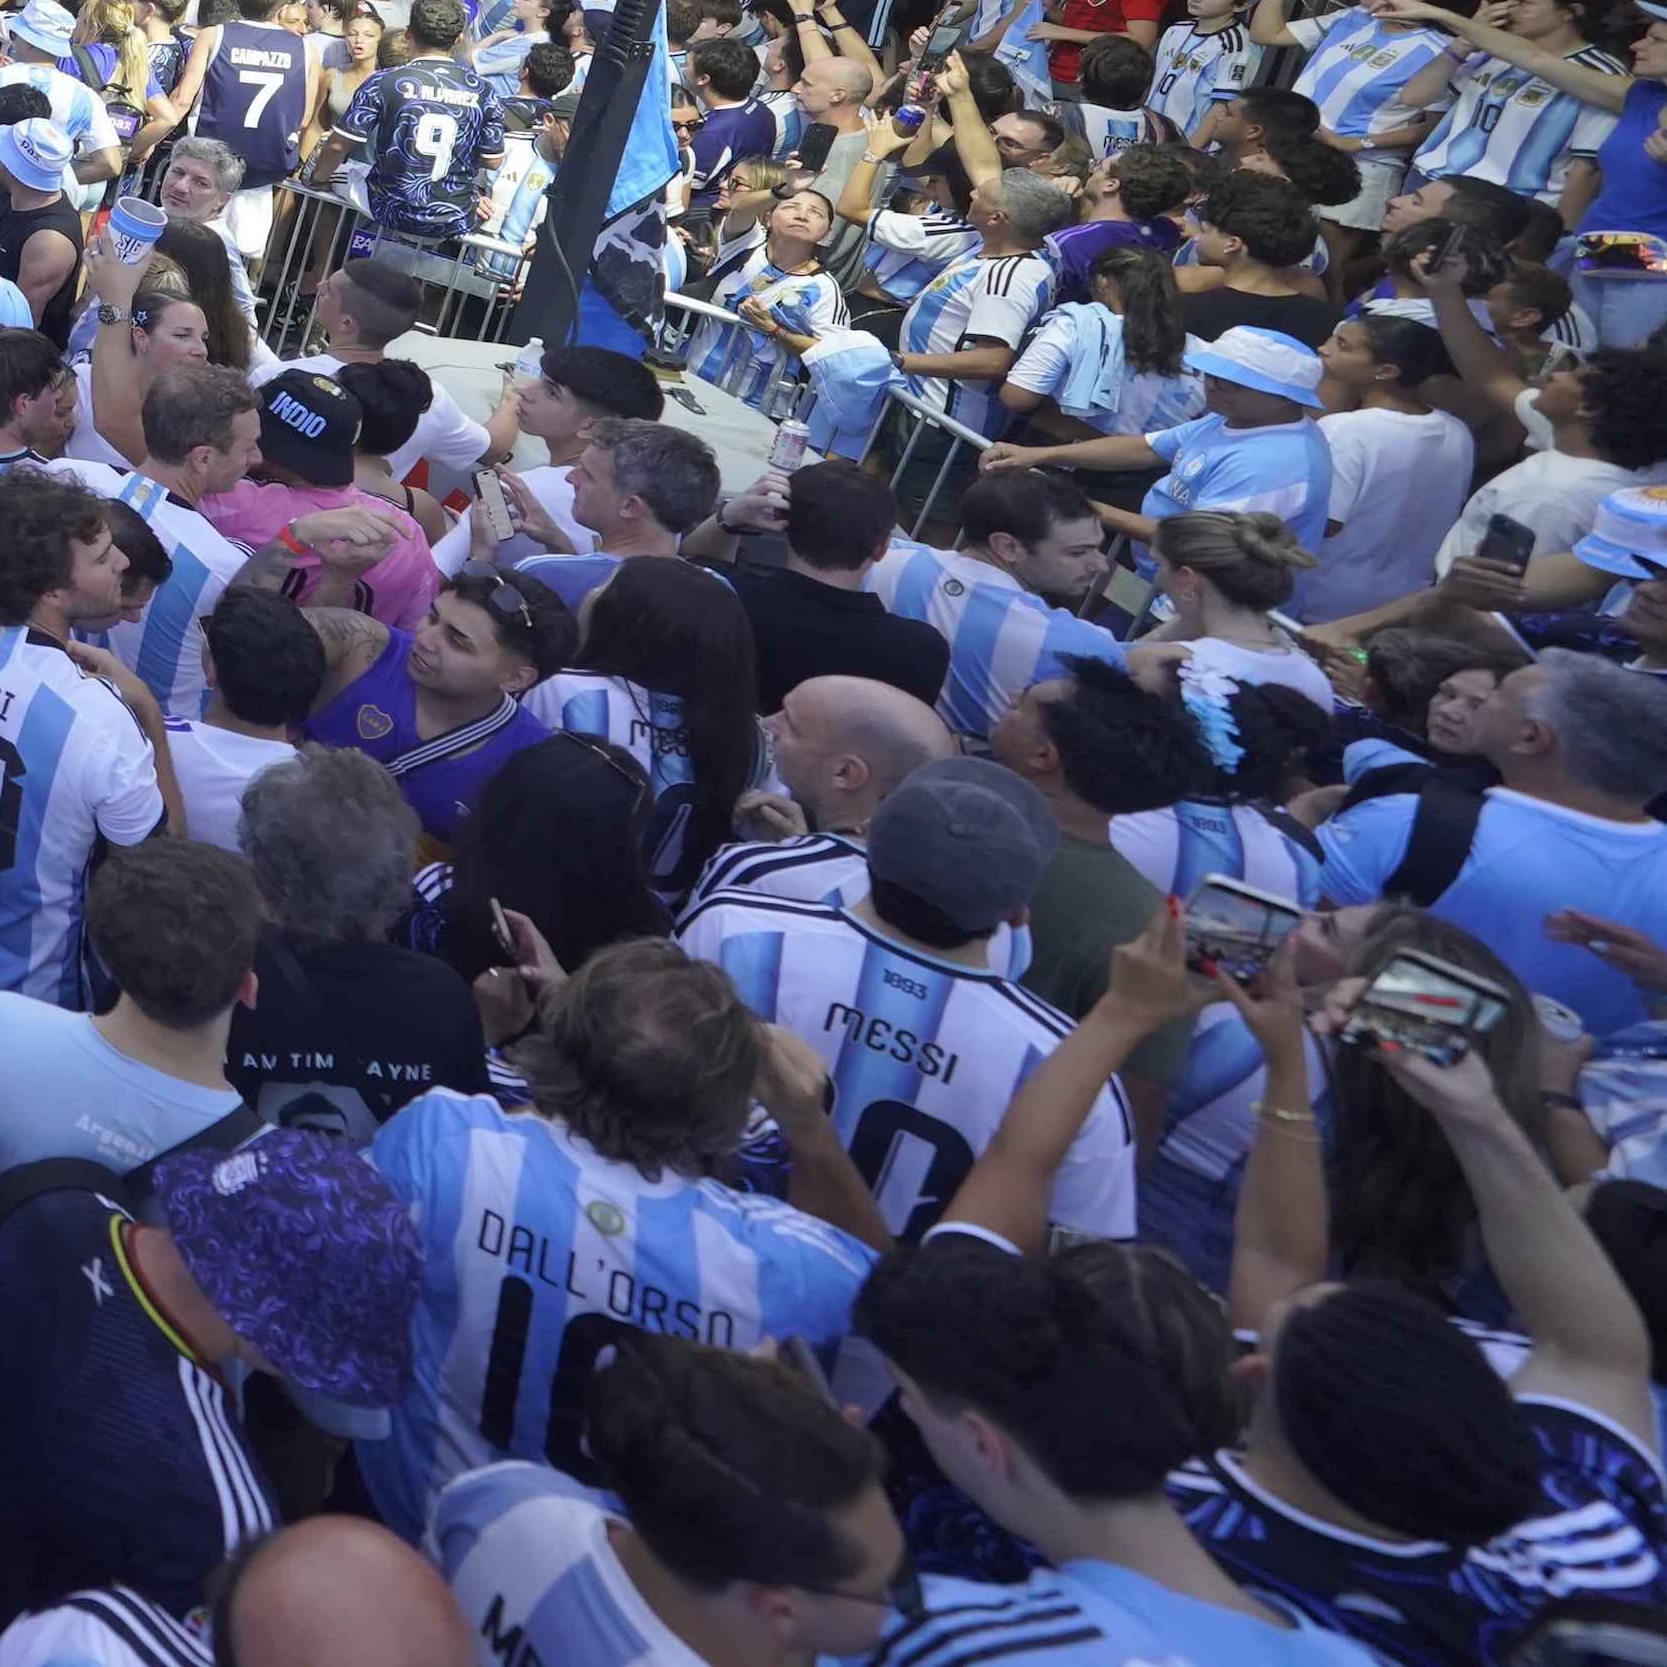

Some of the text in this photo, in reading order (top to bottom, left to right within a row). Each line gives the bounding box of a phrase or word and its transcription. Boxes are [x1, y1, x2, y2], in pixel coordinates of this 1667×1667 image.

[230, 46, 292, 70] CAMPAZZO
[238, 69, 285, 130] 7
[421, 84, 479, 108] ALVAREZ
[19, 139, 41, 162] pax
[414, 111, 460, 183] 9
[1103, 135, 1139, 150] MESS
[268, 390, 328, 440] INDIO
[882, 968, 928, 1002] 1893
[823, 1000, 958, 1086] MESSI
[289, 1051, 335, 1070] TIM
[358, 1057, 433, 1082] AYNE
[478, 1208, 735, 1348] DALL'ORSO
